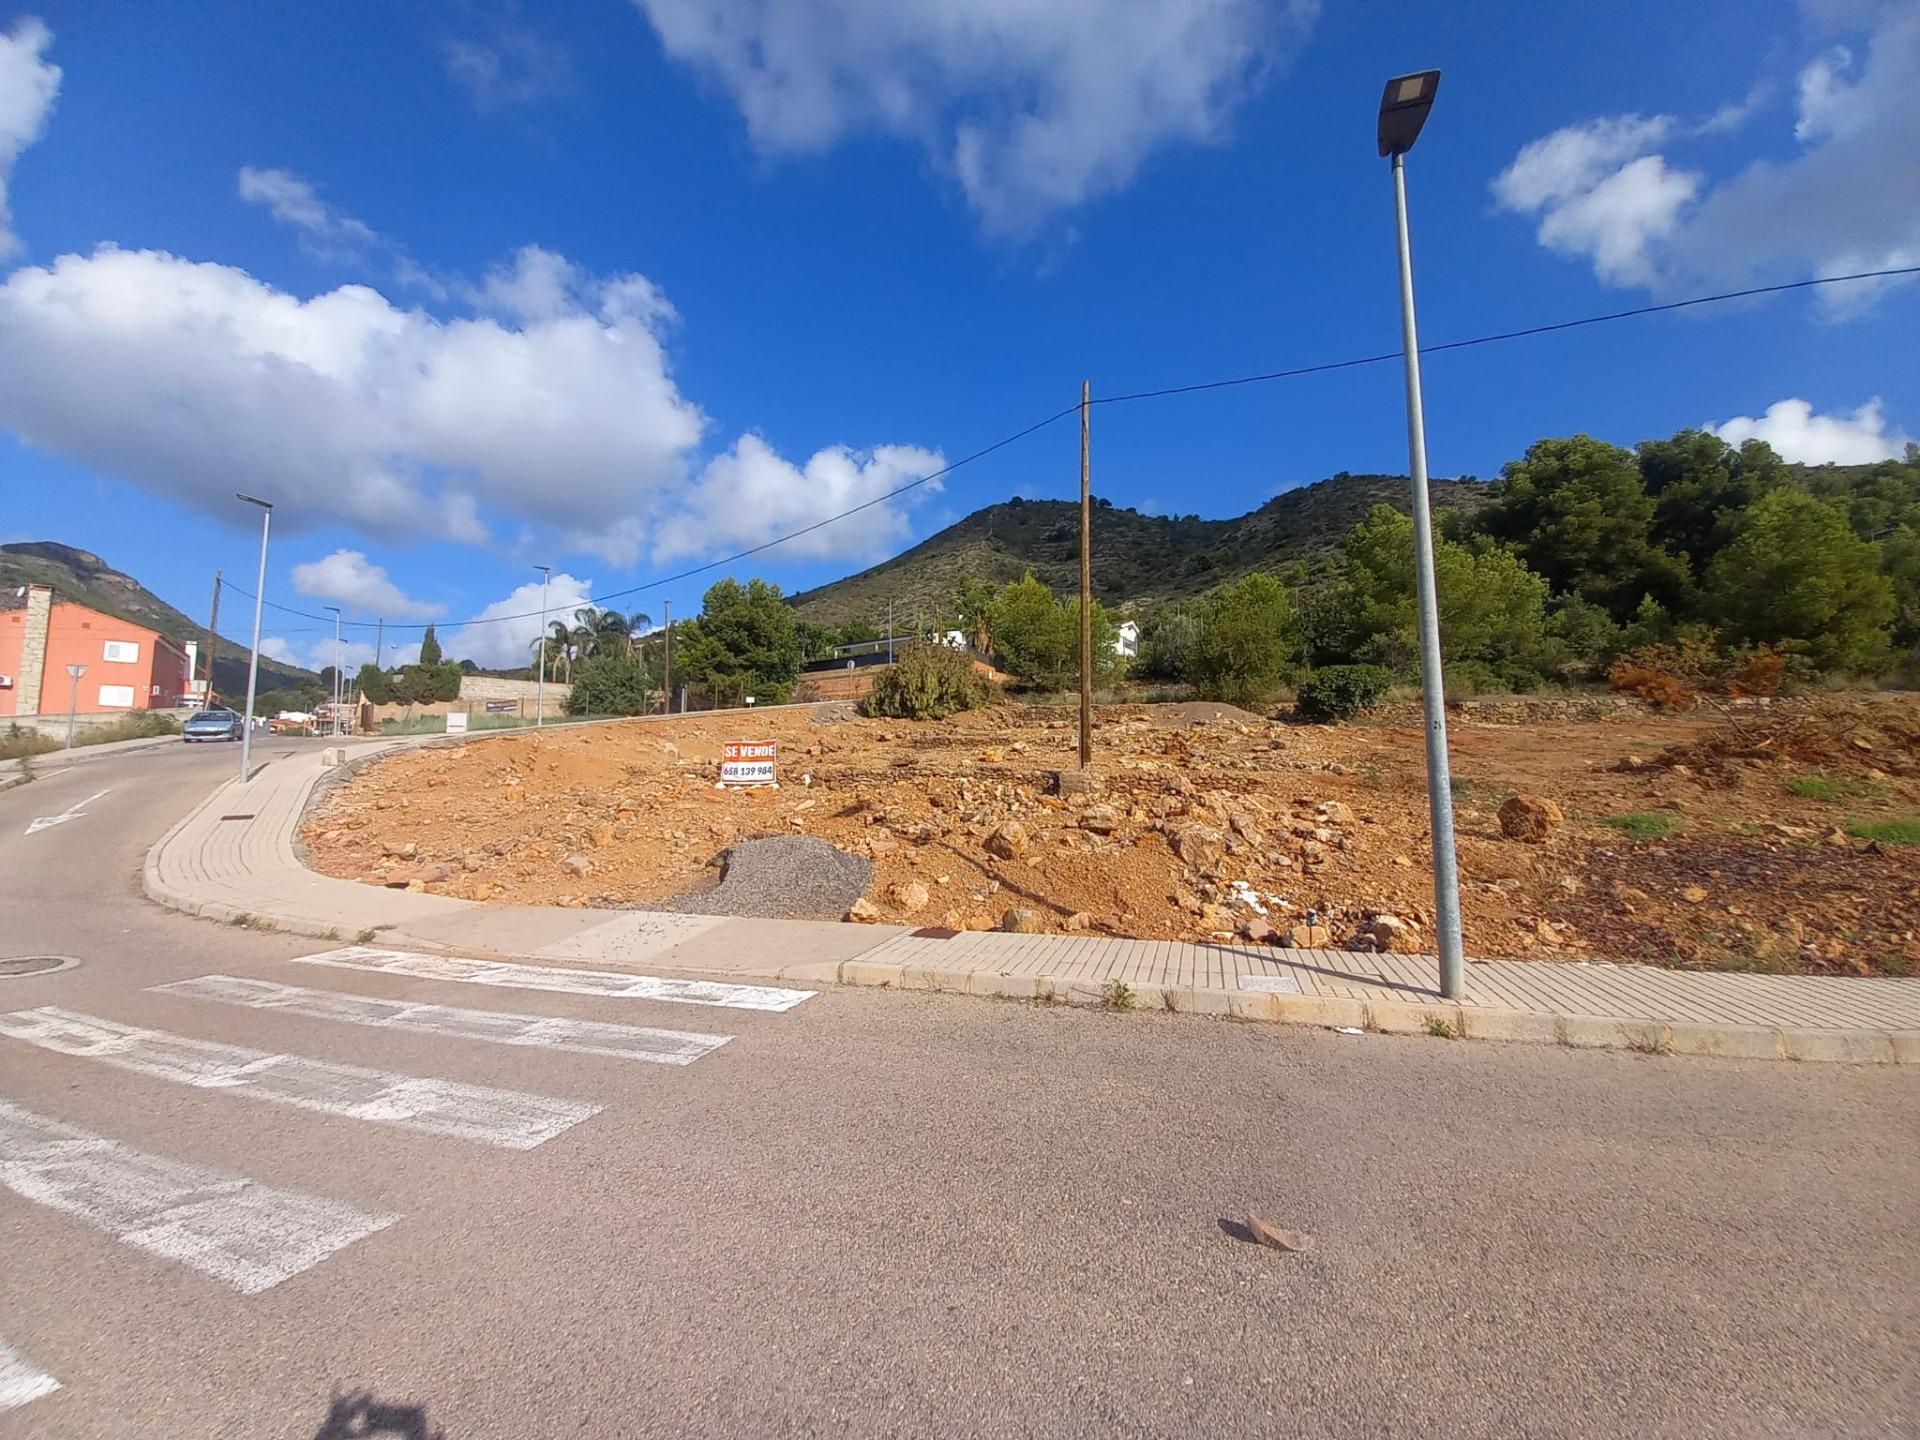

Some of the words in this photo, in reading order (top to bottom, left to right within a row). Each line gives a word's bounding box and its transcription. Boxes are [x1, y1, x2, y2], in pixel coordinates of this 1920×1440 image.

[725, 745, 739, 757] SE
[740, 745, 775, 757] VENDE
[740, 766, 756, 776] 139
